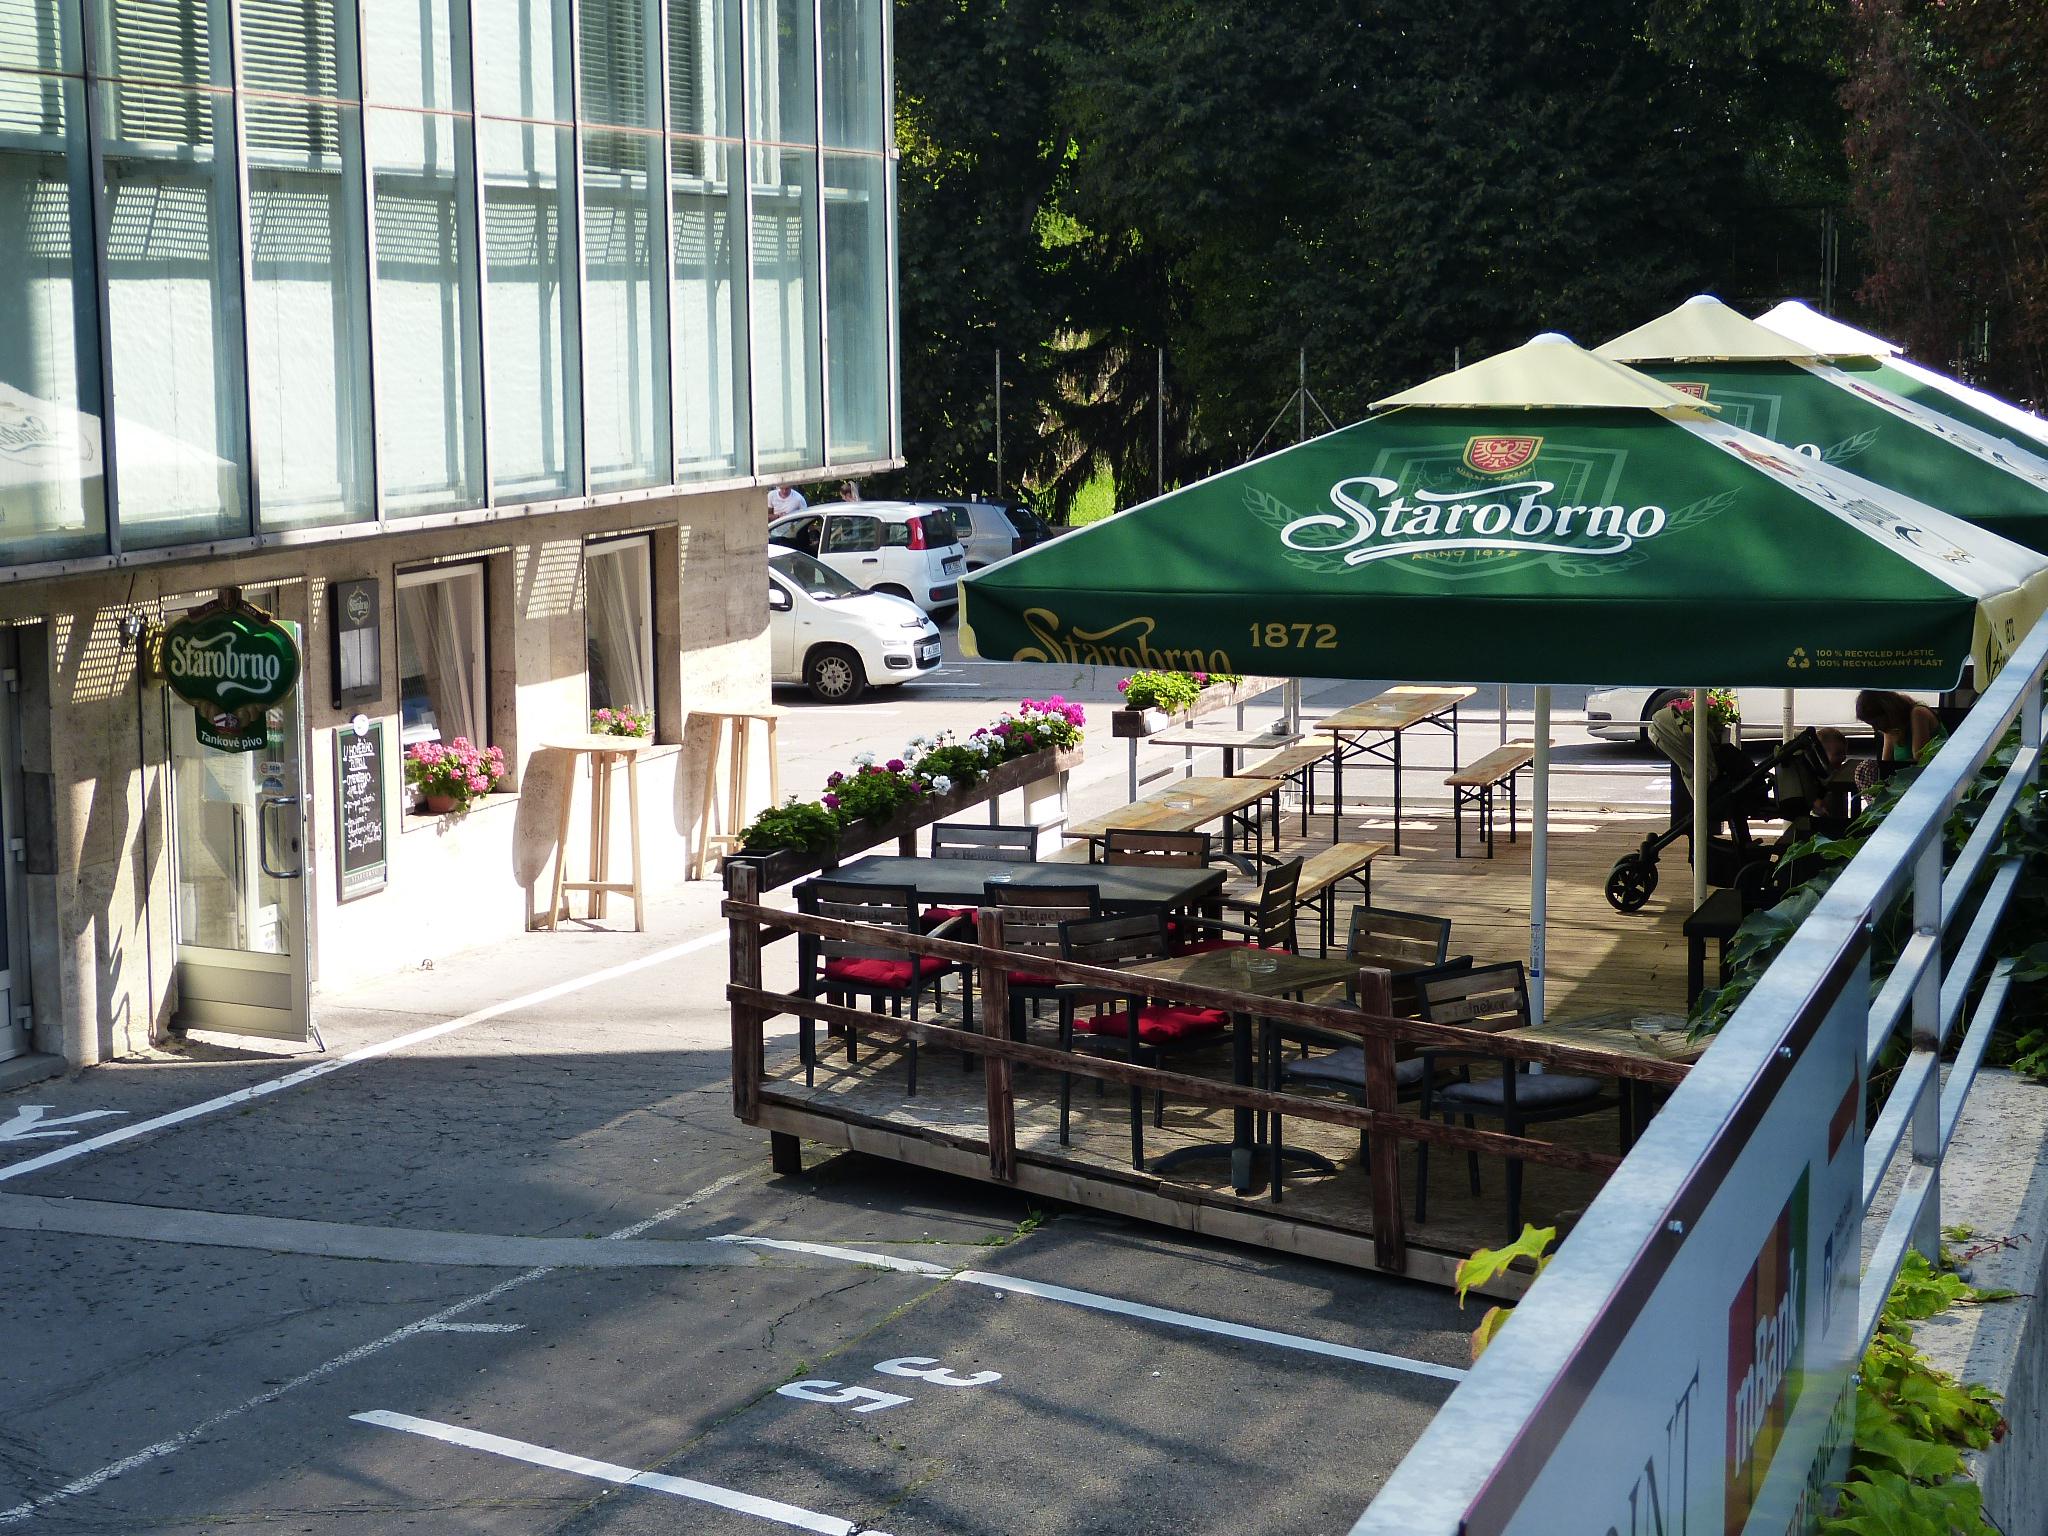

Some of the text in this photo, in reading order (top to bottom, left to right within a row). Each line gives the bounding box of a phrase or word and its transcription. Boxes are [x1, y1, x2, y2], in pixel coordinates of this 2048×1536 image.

[1279, 476, 1668, 567] Starobrno
[1411, 550, 1466, 560] ANNO
[1250, 622, 1339, 649] 1872
[170, 631, 280, 697] Starobrno
[1816, 649, 1833, 658] 100
[1844, 650, 1894, 658] RECYCLED
[1895, 648, 1935, 657] PLASTIC
[1816, 659, 1841, 668] 100%
[1913, 659, 1944, 667] PLAST
[201, 731, 240, 748] Tankové
[242, 735, 263, 750] pivo
[1735, 1246, 1800, 1479] mBank
